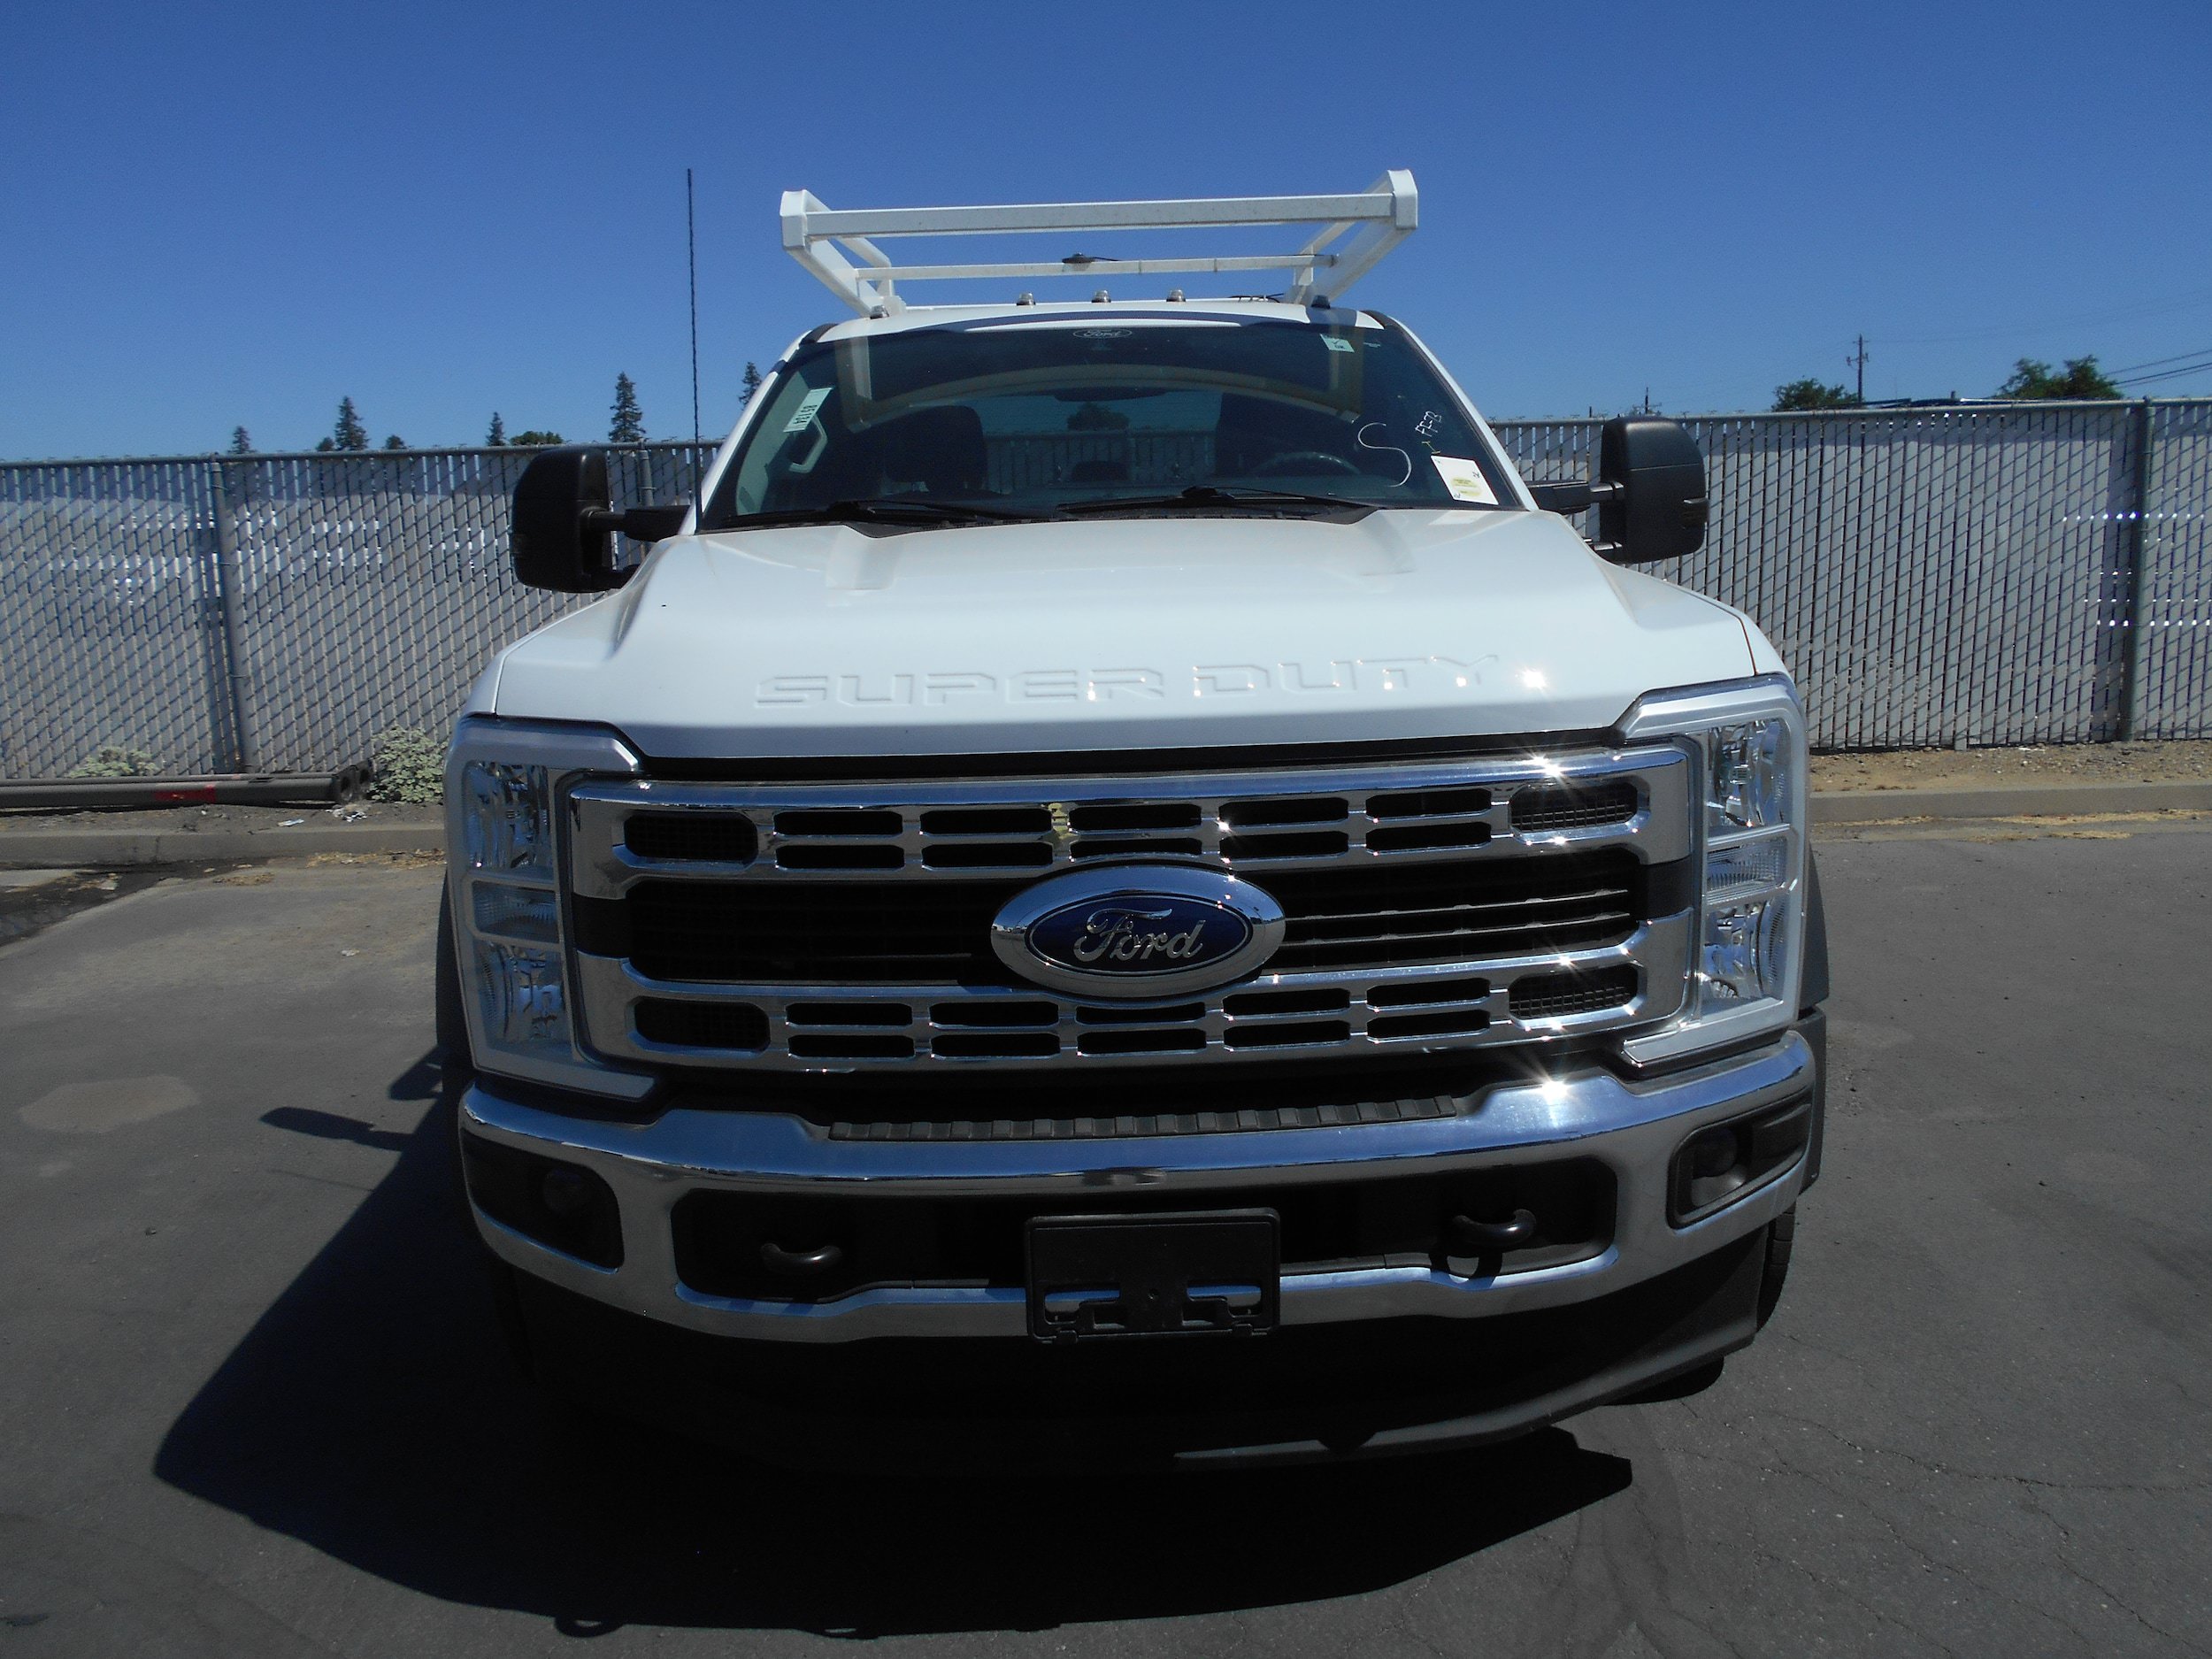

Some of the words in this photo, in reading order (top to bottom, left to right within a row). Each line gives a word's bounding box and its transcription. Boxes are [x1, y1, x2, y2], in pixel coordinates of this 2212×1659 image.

[755, 668, 1164, 709] SUPER
[1193, 654, 1499, 697] DUTY
[1072, 907, 1207, 962] Ford
